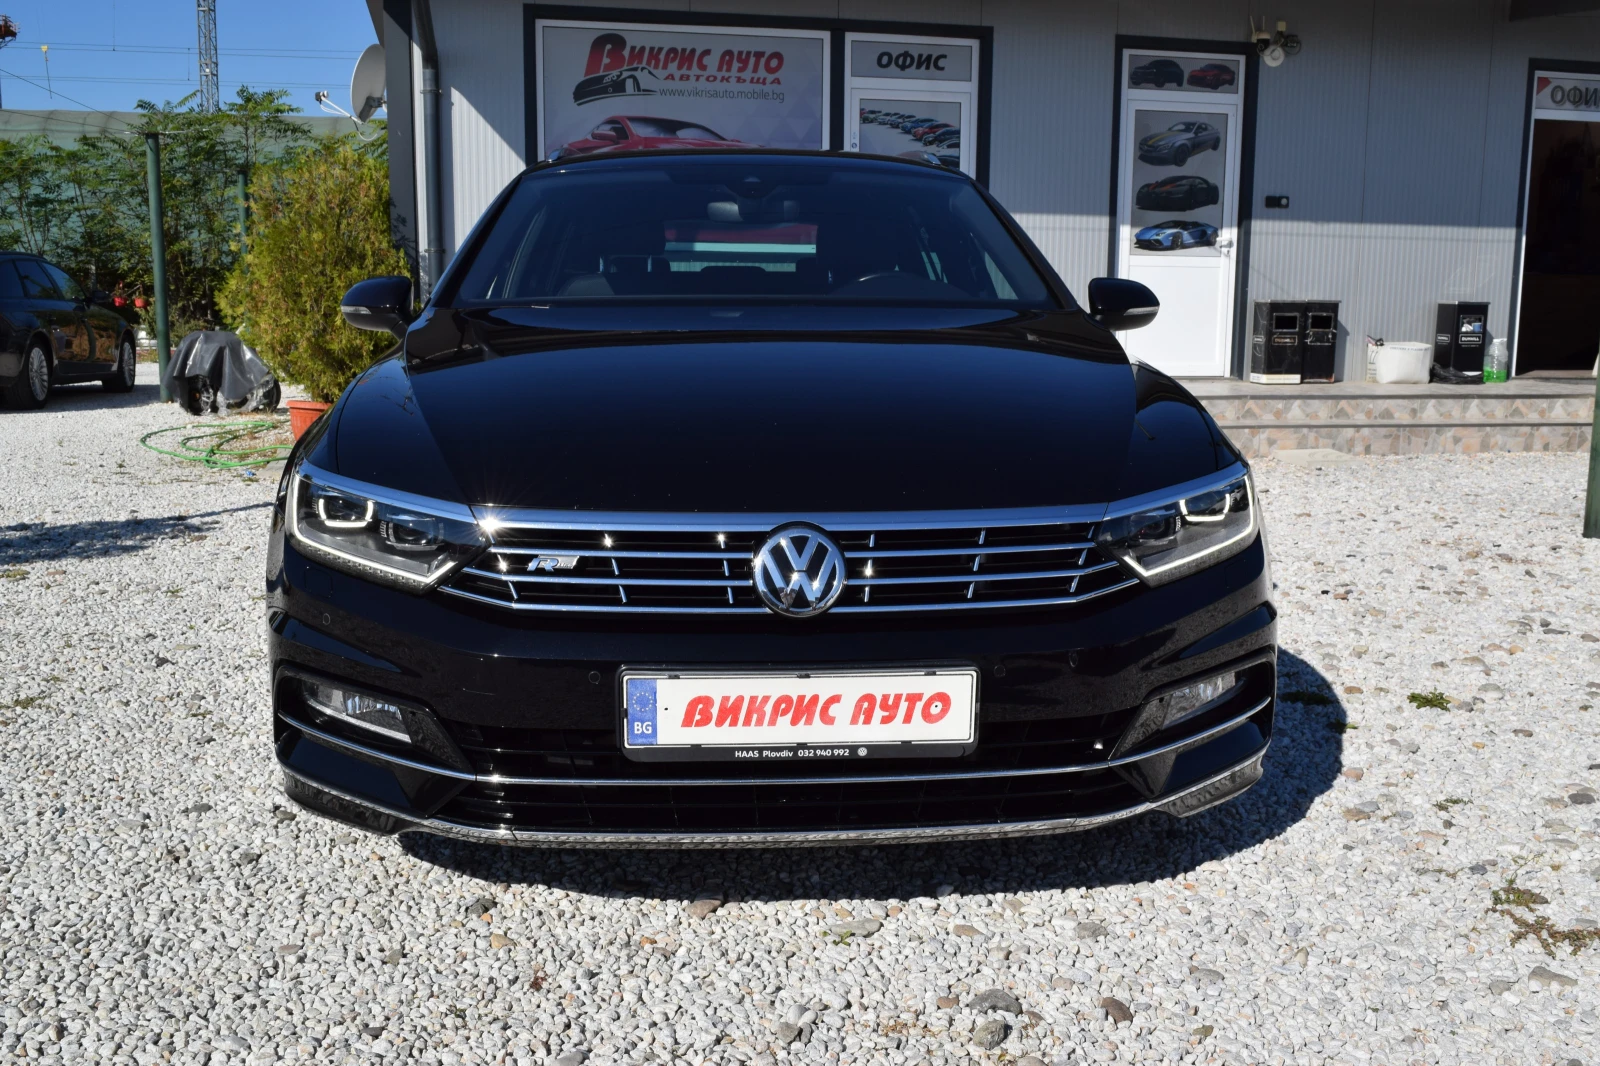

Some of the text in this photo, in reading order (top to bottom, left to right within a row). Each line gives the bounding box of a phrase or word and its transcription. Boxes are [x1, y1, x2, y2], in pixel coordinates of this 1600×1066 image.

[716, 49, 785, 75] АУТО
[876, 50, 948, 71] ОФИС
[663, 73, 782, 86] АВТОКЪЩА
[659, 86, 785, 103] www.vikrisauto.mobile.bg
[1550, 85, 1600, 107] ОФИ
[680, 691, 952, 728] ВИКРИС АУТО
[633, 721, 652, 734] BG
[735, 750, 759, 758] HAAS
[762, 750, 793, 758] Plovdiv
[797, 749, 815, 757] 032
[816, 749, 832, 757] 940
[833, 748, 850, 756] 992
